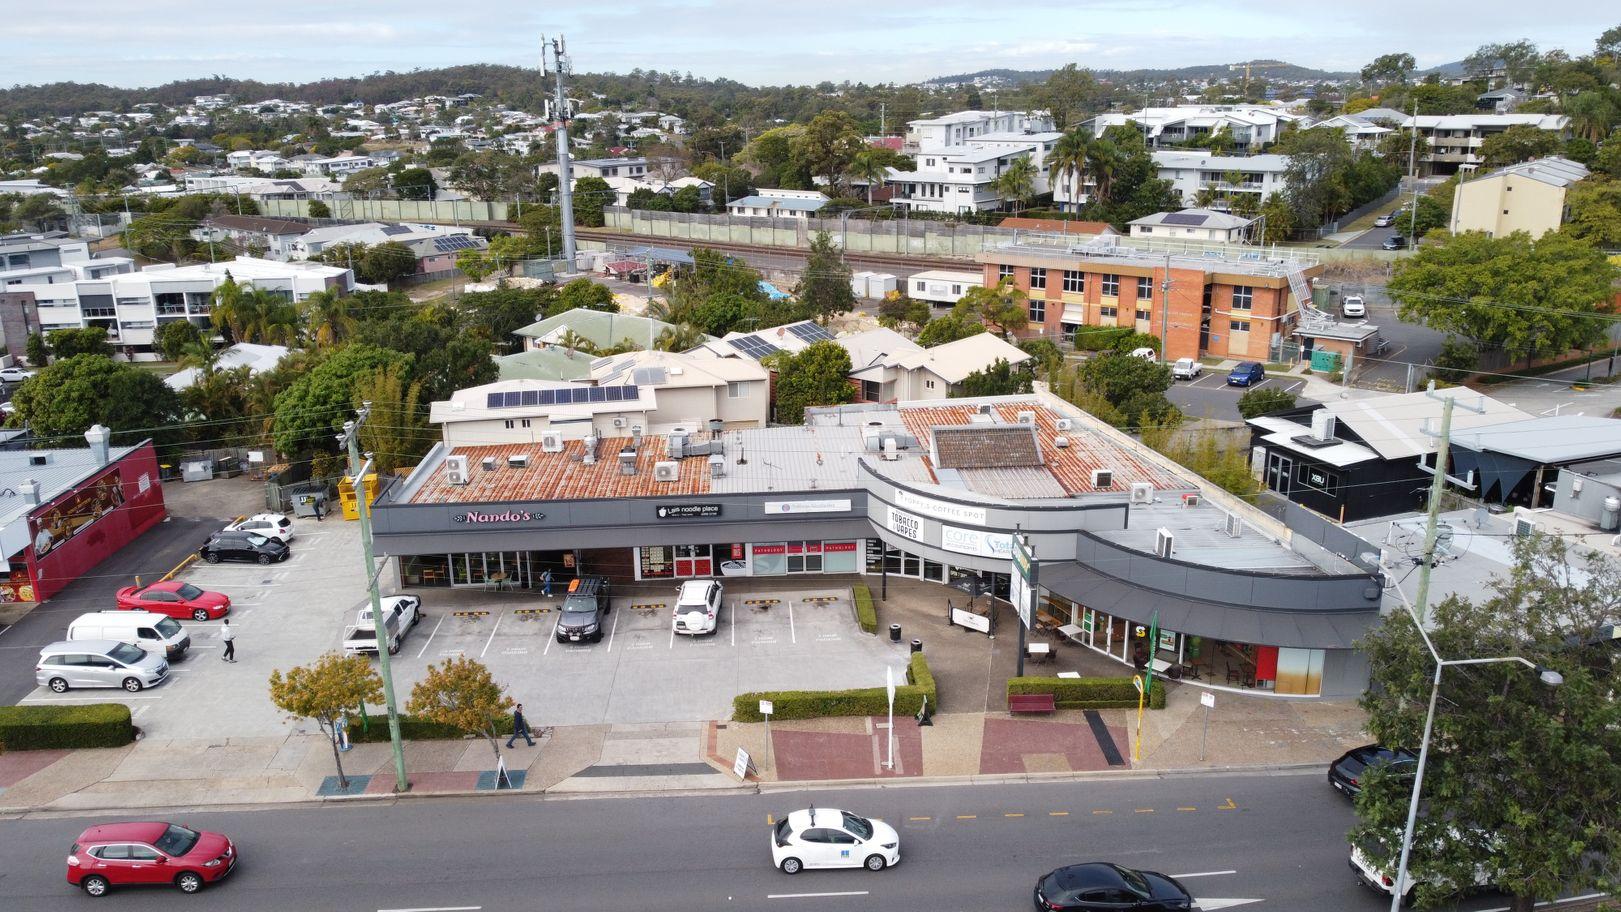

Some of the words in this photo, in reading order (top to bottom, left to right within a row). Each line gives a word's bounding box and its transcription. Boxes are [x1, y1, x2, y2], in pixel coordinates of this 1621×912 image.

[466, 510, 531, 523] Nando's
[891, 512, 919, 530] TOBACCO
[963, 511, 985, 519] SPOT
[896, 524, 917, 538] VAPES
